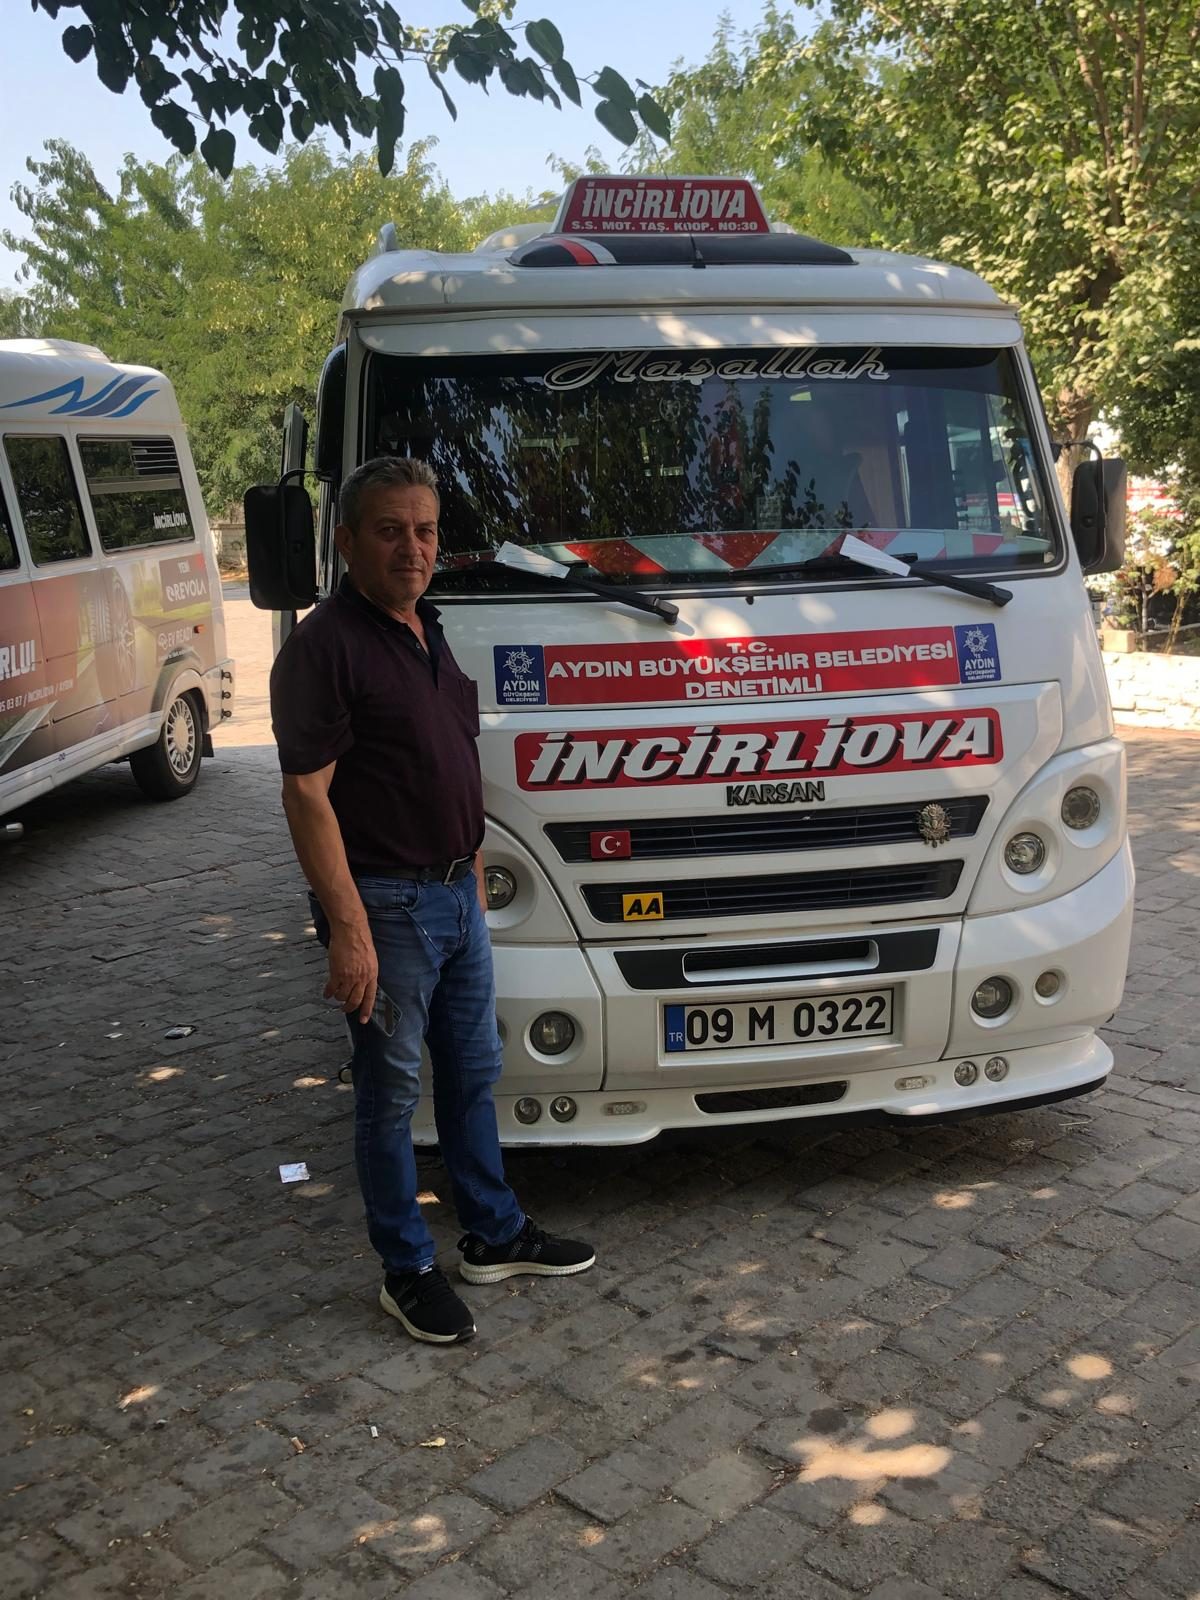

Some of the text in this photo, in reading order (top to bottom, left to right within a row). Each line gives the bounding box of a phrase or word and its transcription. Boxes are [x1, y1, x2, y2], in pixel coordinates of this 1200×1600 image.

[581, 181, 746, 219] İNCİRLİOVA
[571, 221, 758, 233] S.S. MOT. TAŞ. KOOP. NO:30
[543, 347, 891, 391] Maşallah
[548, 639, 954, 678] AYDIN BÜYÜKŞEHİR BELEDİYESİ
[726, 641, 775, 654] T.C.
[964, 657, 996, 671] AYDIN
[503, 680, 540, 691] AYDIN
[685, 673, 823, 699] DENETİMLİ
[526, 716, 995, 785] İNCİRLİOVA
[726, 781, 826, 807] KARSAN
[626, 897, 662, 917] AA
[669, 995, 887, 1045] TR 09 M 0322
